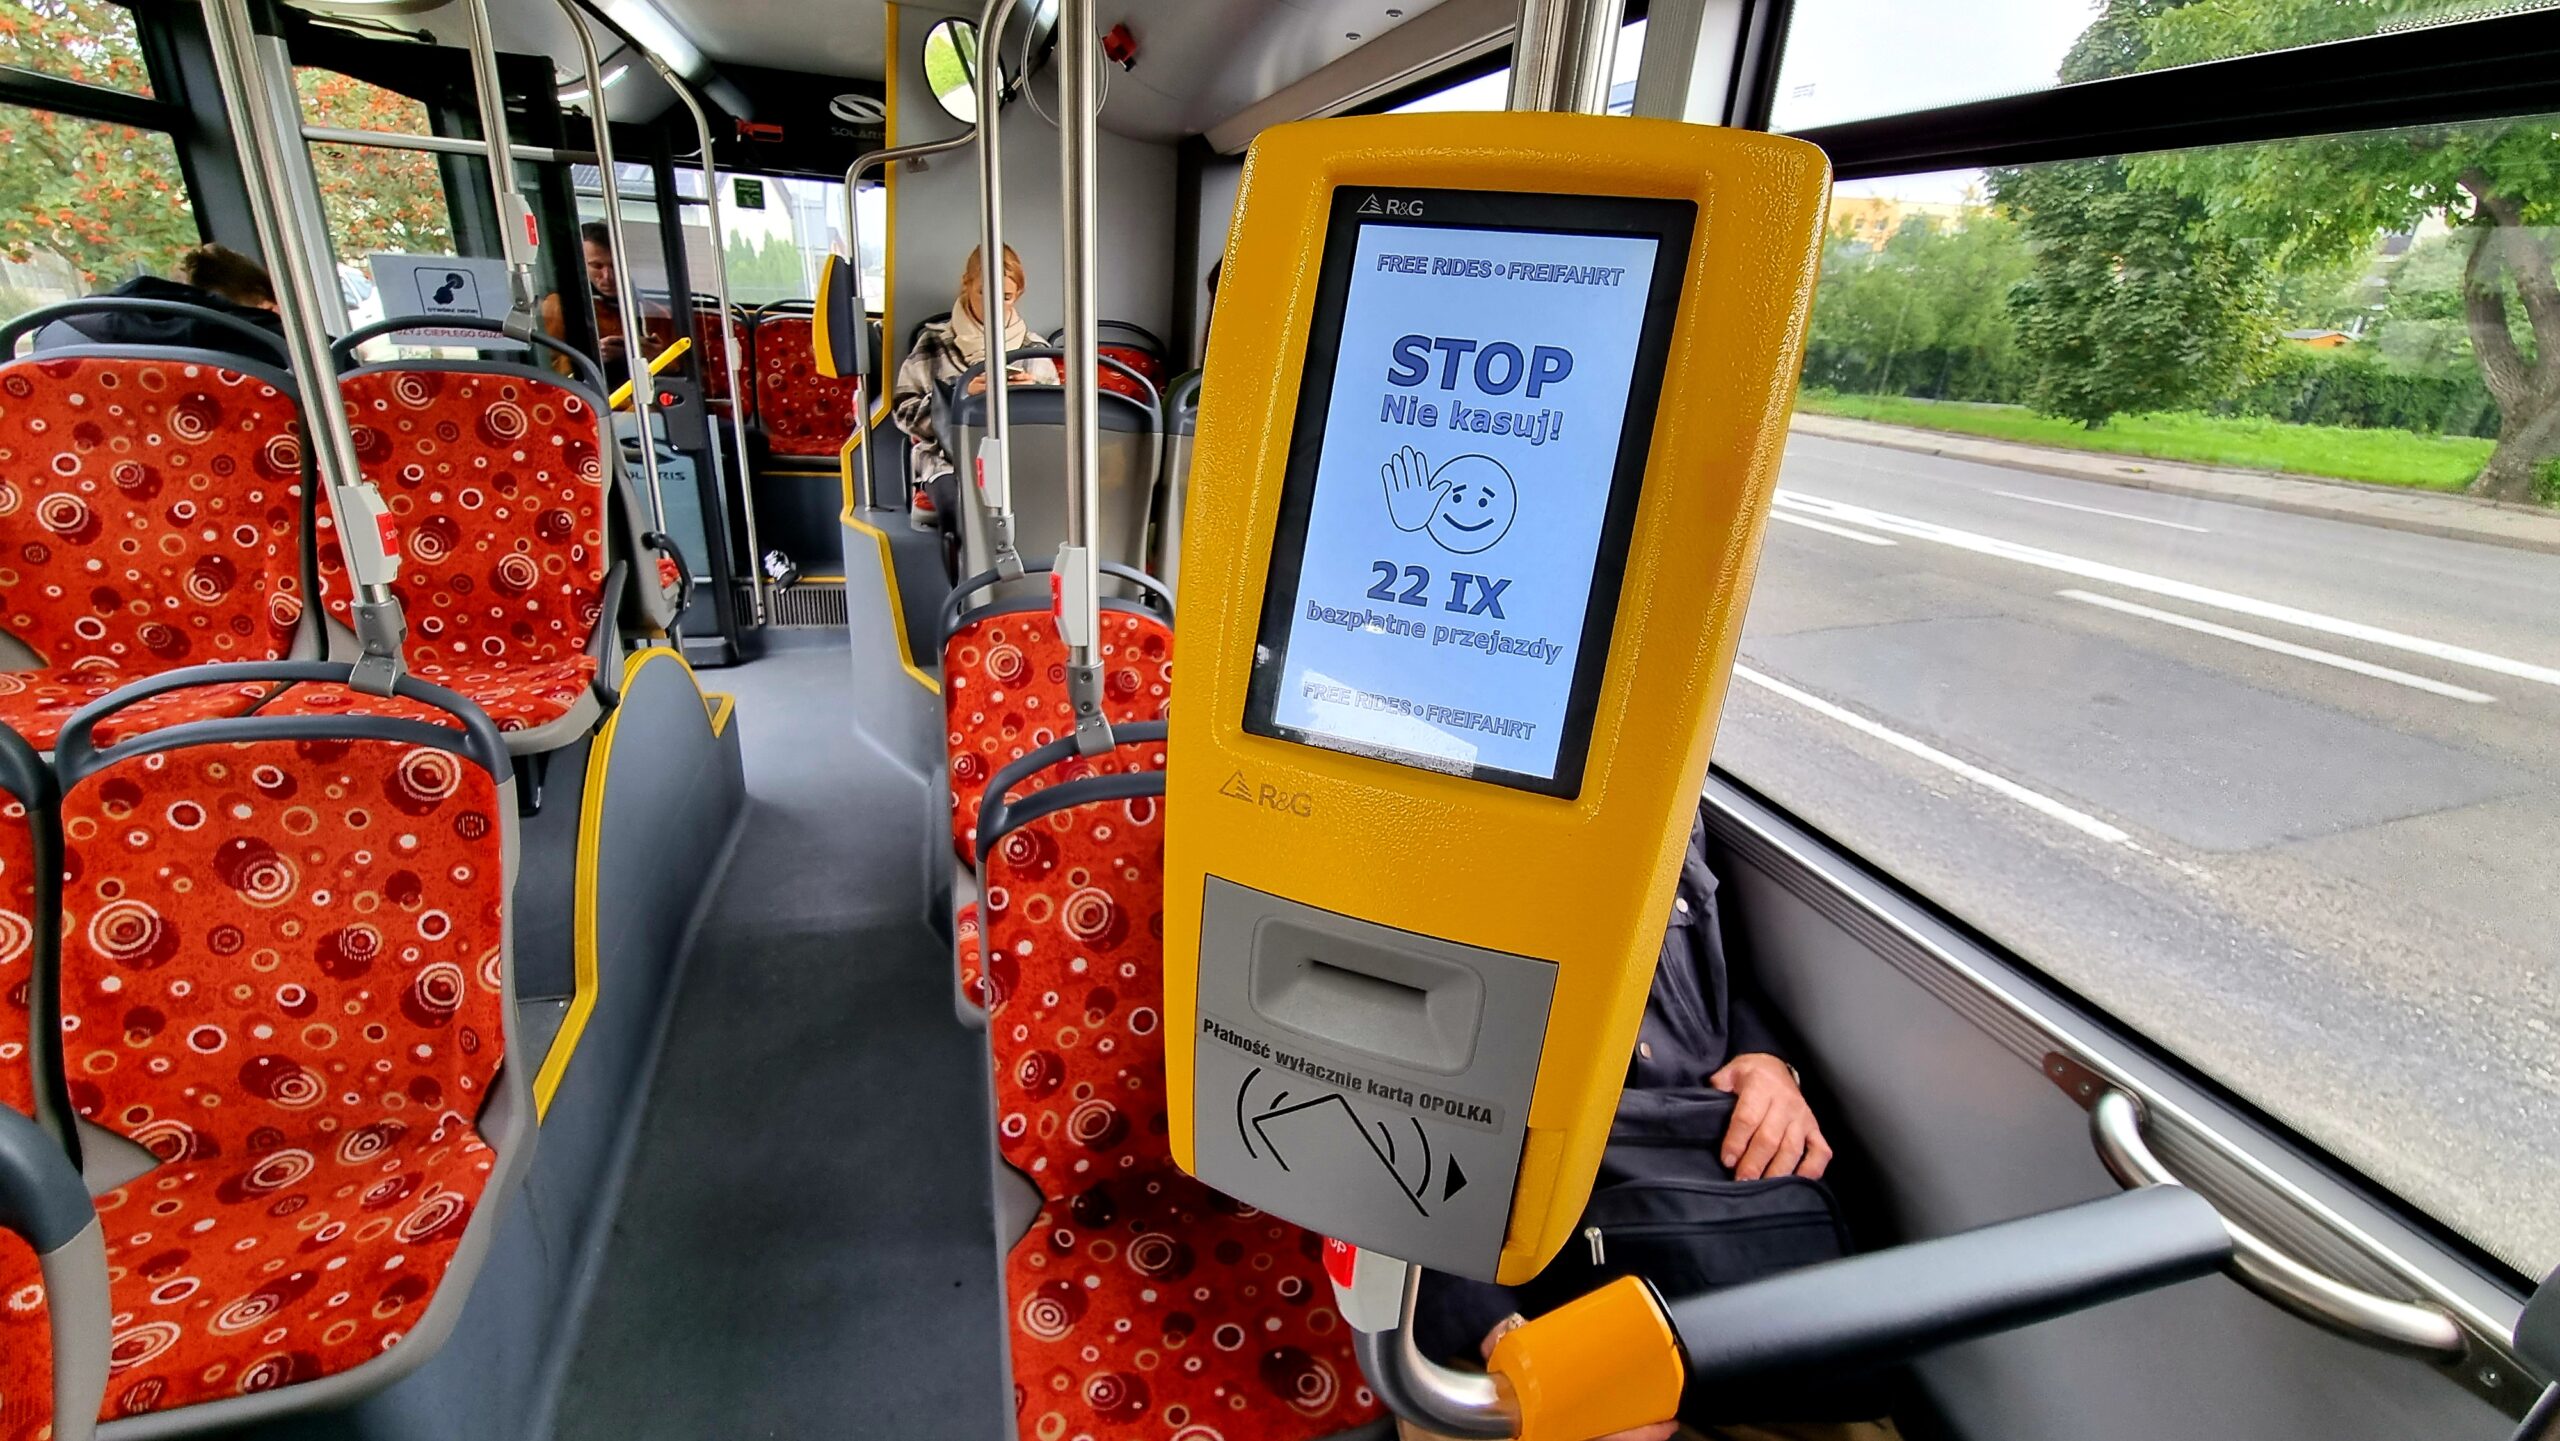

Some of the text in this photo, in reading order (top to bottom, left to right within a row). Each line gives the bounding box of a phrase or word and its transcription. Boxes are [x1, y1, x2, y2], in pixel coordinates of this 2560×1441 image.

[1386, 199, 1424, 217] R&G
[1376, 254, 1625, 287] FREE RIDES FREIFAHRT
[1386, 334, 1574, 399] STOP
[1380, 394, 1564, 446] Nie kasuj!
[1366, 560, 1512, 620] 22 IX
[1306, 599, 1563, 666] bezpłatne przejazdy
[1303, 681, 1536, 741] FREE RIDES FREIFAHRT
[1258, 783, 1312, 818] R&G
[1203, 1018, 1493, 1125] Płatność wyłącznie kartą OPOLKA
